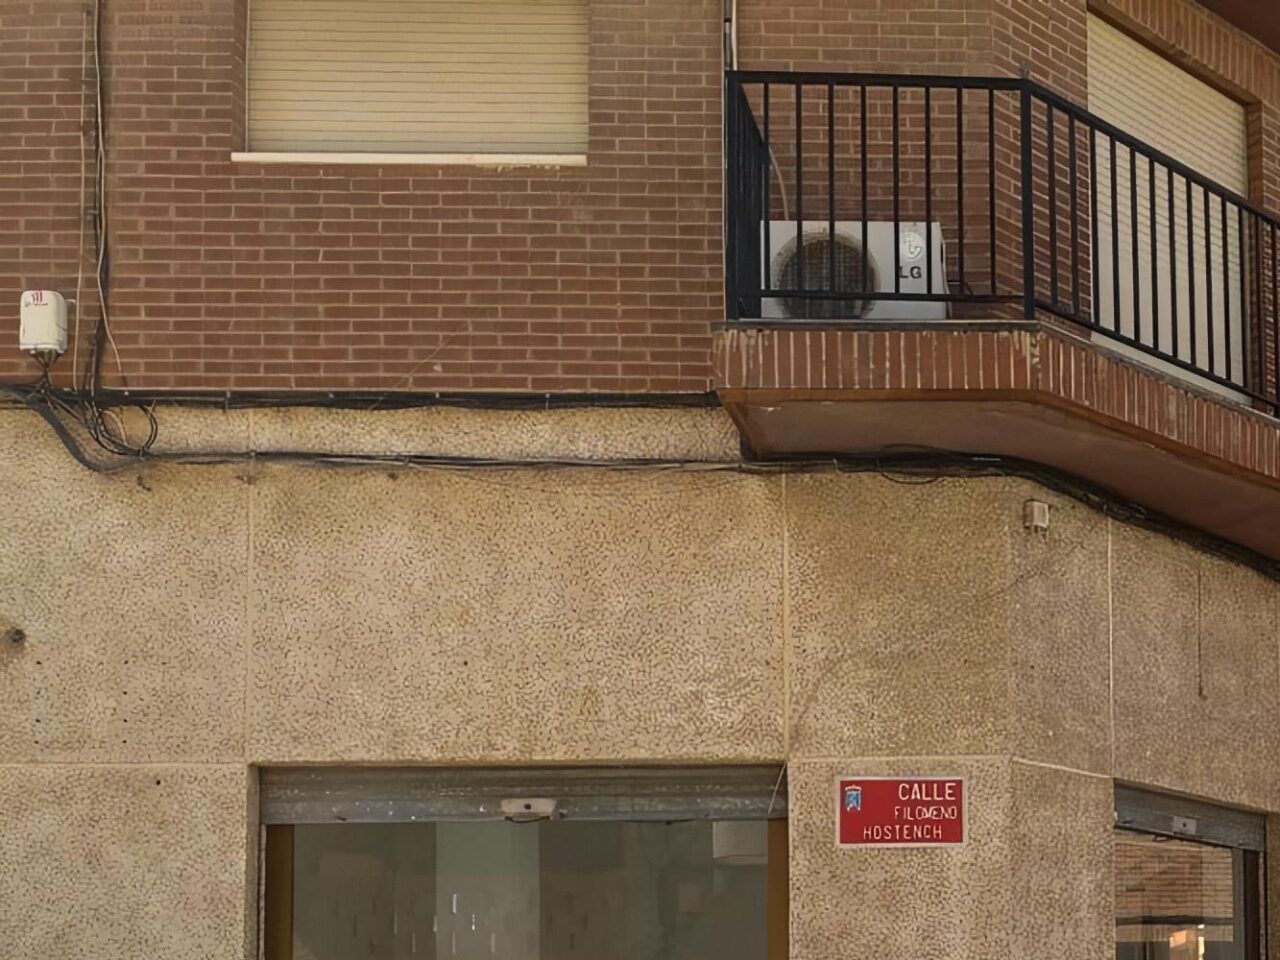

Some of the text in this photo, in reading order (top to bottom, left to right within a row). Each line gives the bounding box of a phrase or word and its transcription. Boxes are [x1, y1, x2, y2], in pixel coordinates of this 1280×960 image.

[898, 265, 923, 280] LG
[898, 782, 957, 801] CALLE
[894, 805, 958, 821] FILOMENO
[862, 824, 942, 841] HOSTENCH
